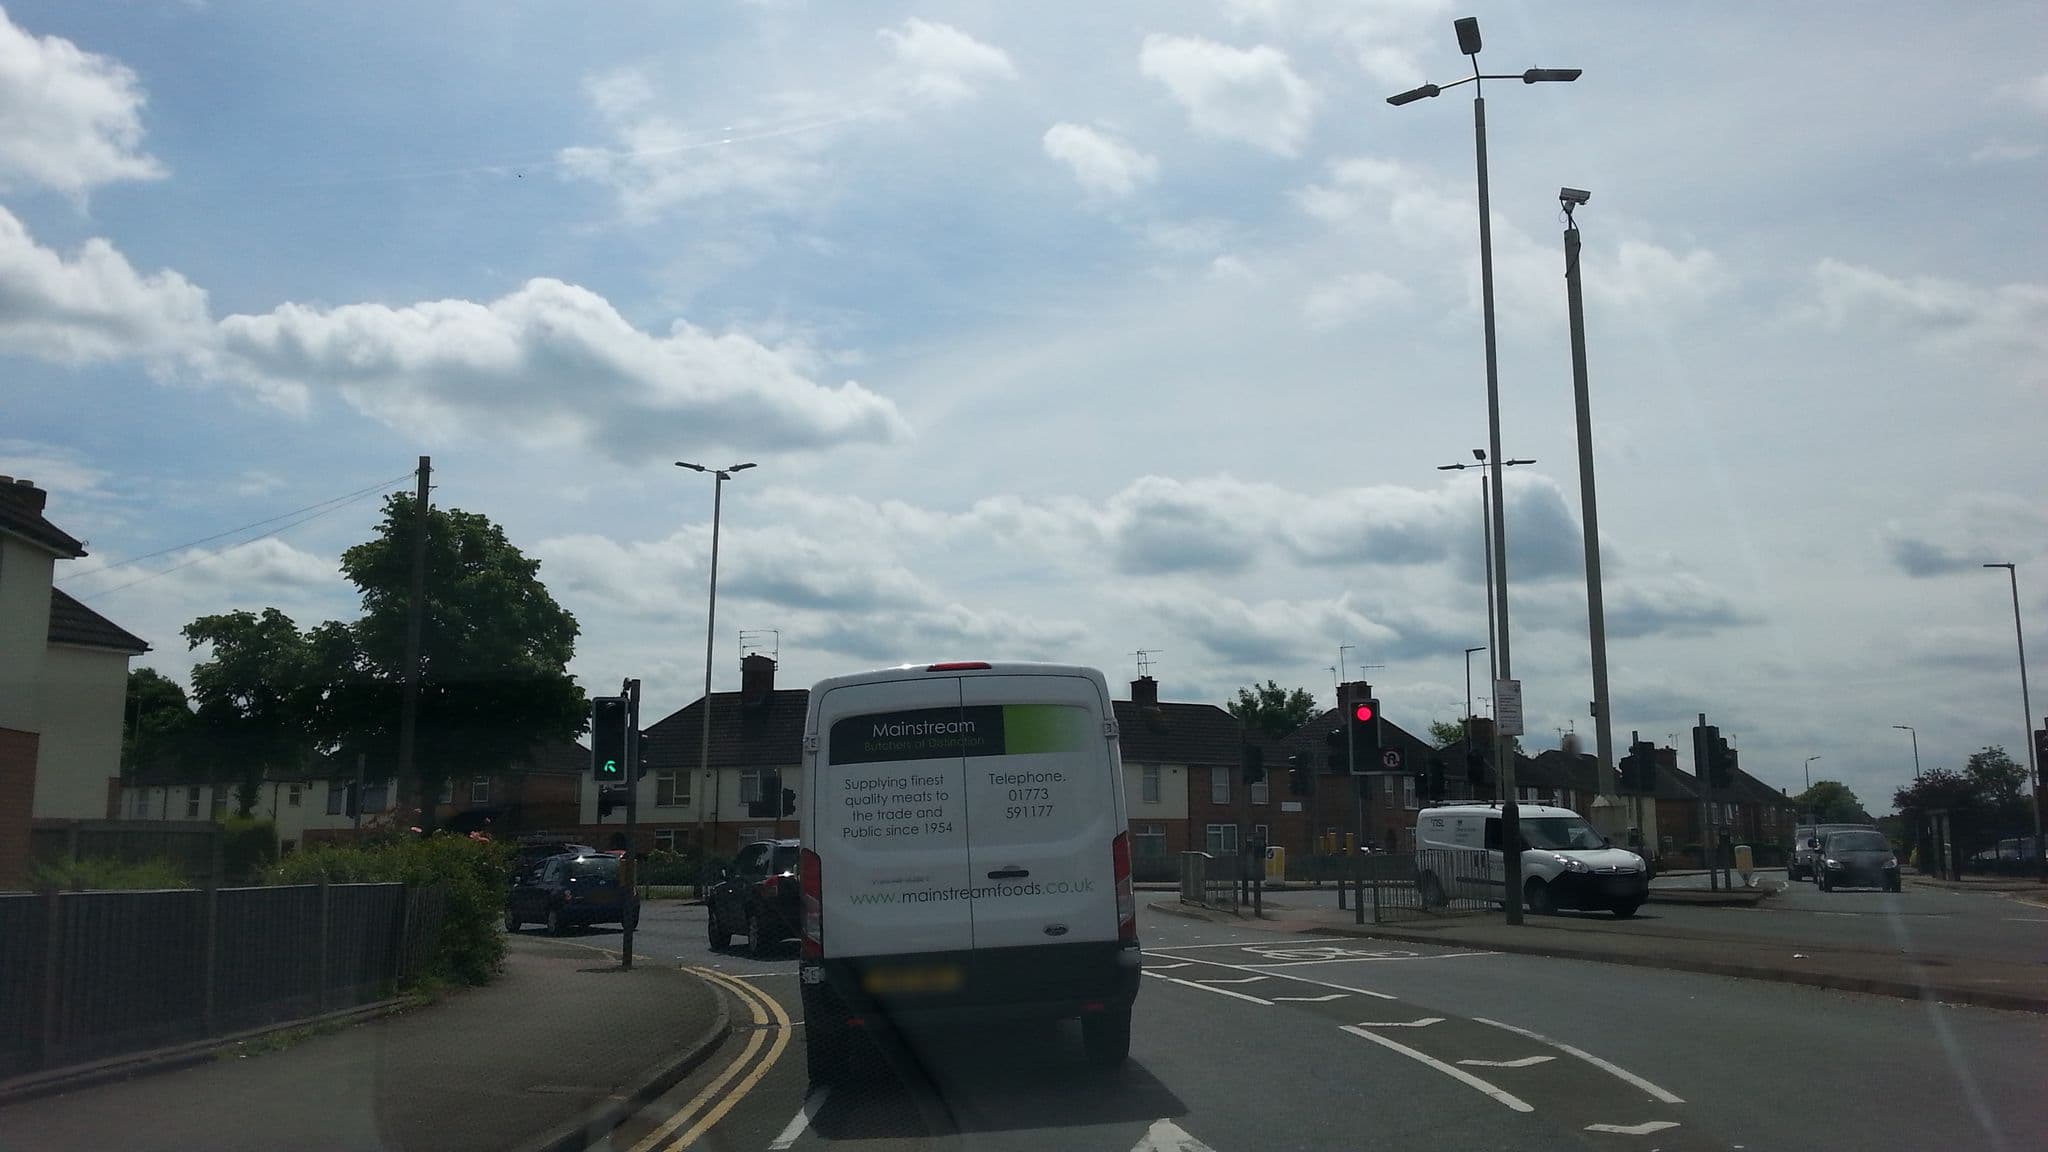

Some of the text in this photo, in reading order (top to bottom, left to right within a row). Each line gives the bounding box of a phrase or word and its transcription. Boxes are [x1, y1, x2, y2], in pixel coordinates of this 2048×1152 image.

[872, 720, 975, 738] Mainstream
[844, 774, 944, 791] Supplying finest
[845, 791, 949, 808] quality meats to
[1008, 788, 1049, 801] 01773
[852, 806, 943, 822] the trade and
[1006, 805, 1053, 819] 591177
[843, 822, 953, 838] Public since 1954
[850, 878, 1094, 905] www.mainstreamfoods.co.uk
